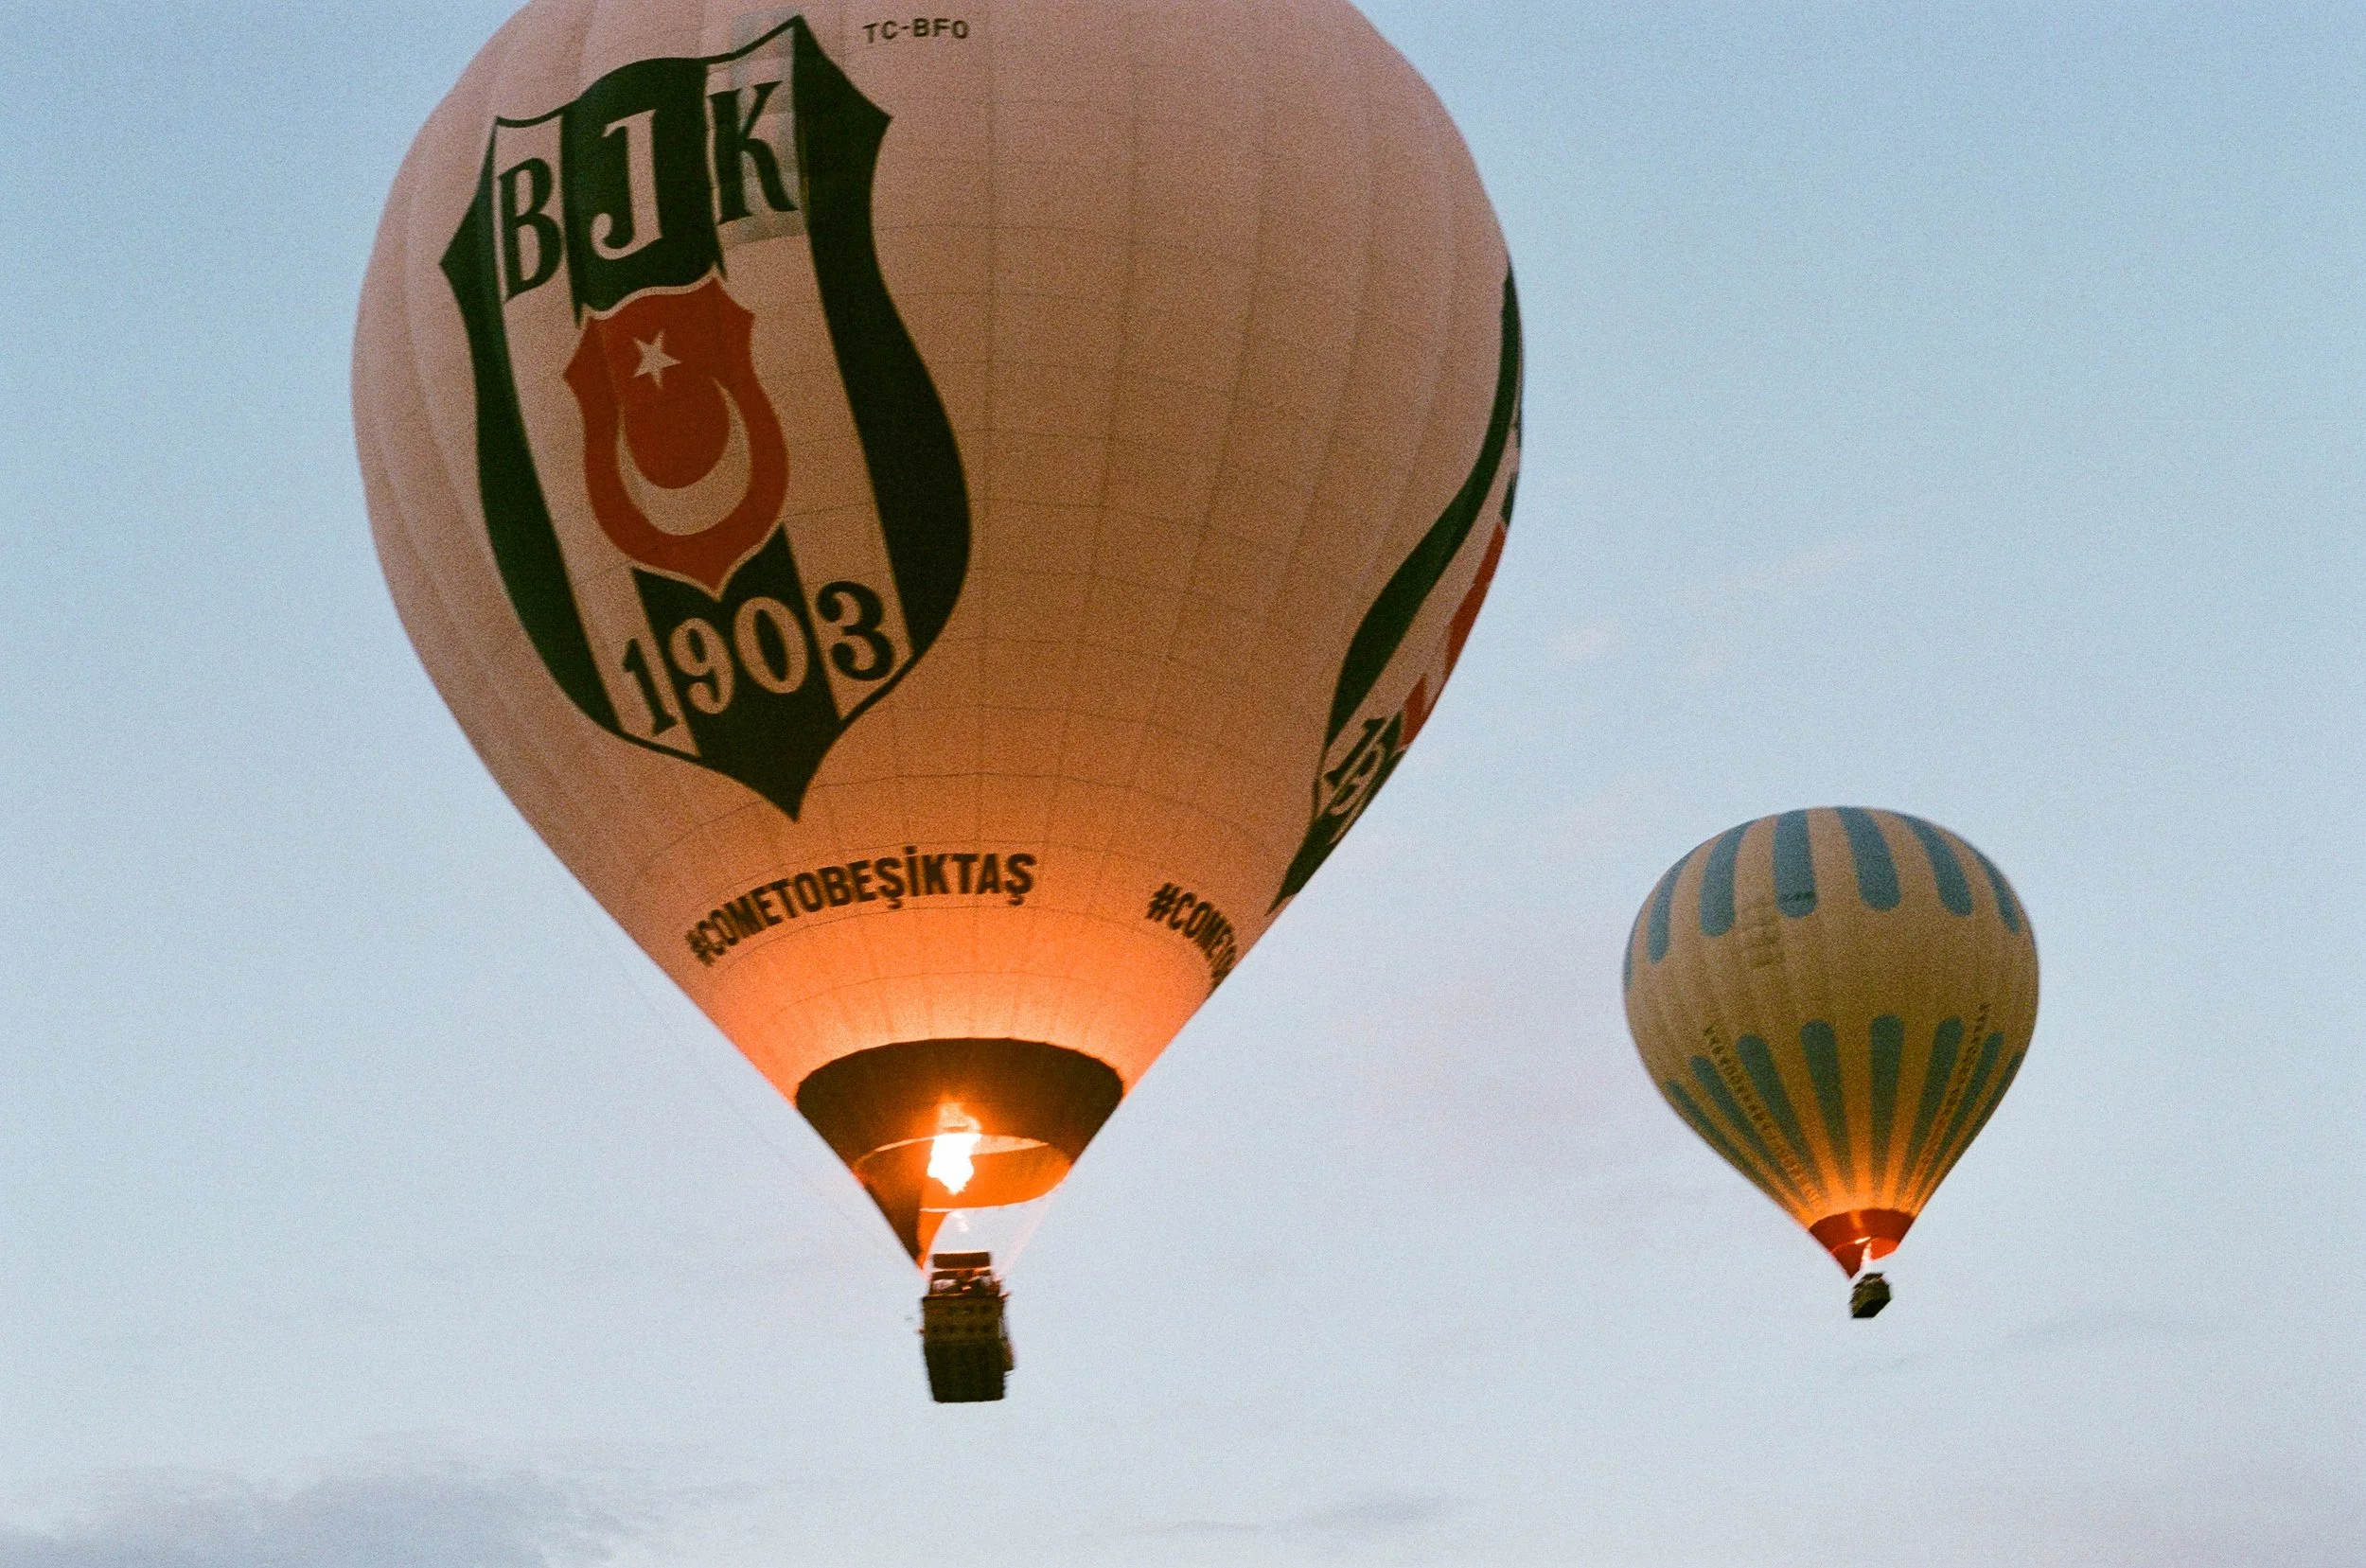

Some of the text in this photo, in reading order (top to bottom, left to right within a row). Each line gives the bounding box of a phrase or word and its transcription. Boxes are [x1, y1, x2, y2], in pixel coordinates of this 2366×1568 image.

[498, 79, 800, 303] BJK
[623, 580, 896, 736] 1903
[685, 845, 1037, 967] #COMETOBEŞİKTAŞ
